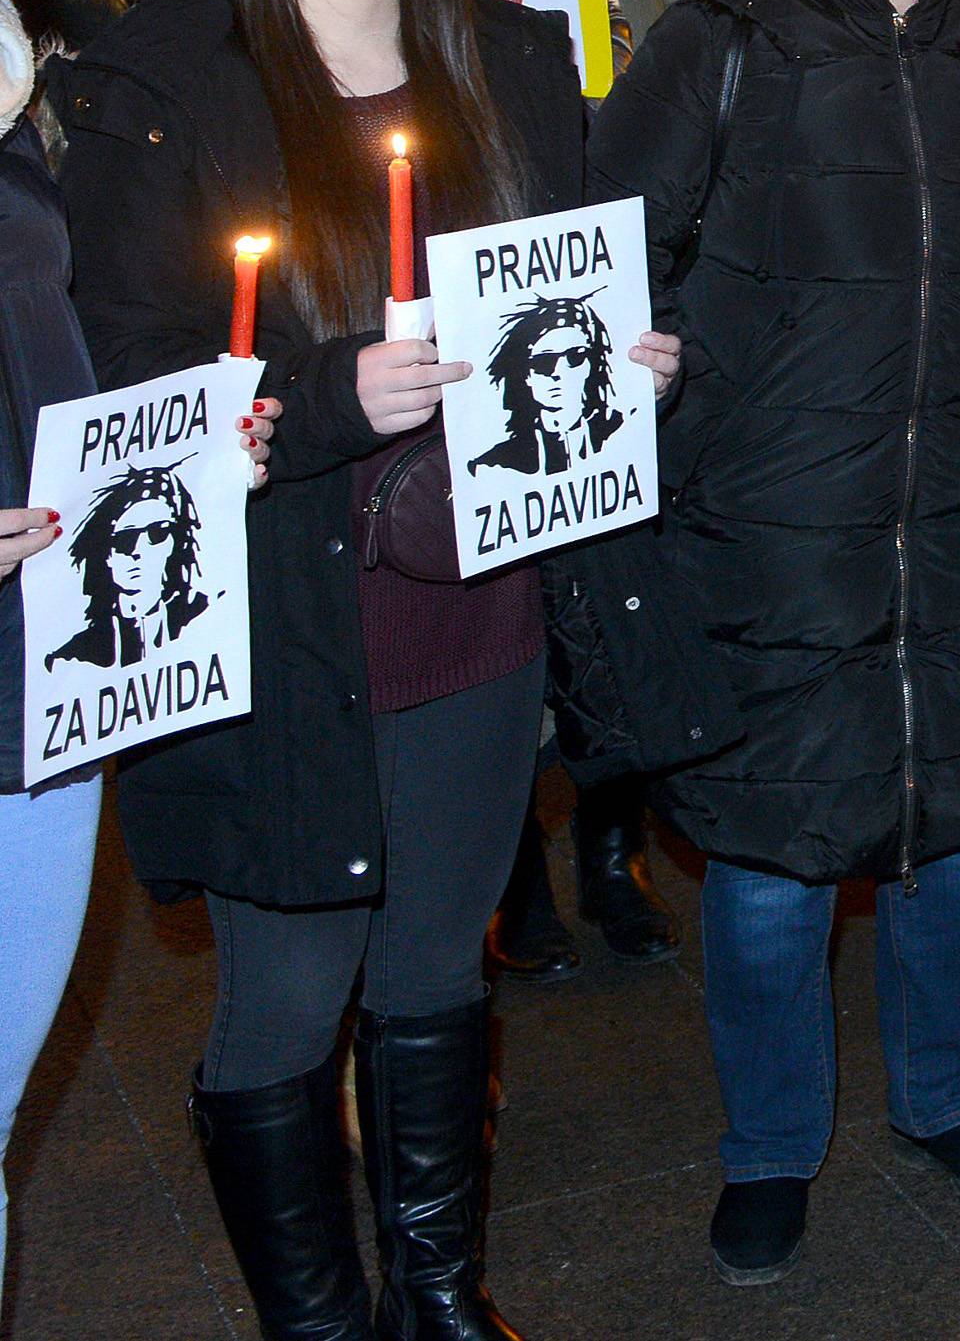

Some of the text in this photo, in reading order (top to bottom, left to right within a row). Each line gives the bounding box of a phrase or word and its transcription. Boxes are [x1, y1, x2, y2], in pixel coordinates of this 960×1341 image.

[475, 226, 613, 297] PRAVDA
[80, 387, 208, 472] PRAVDA
[475, 464, 643, 556] ZA DAVIDA
[43, 653, 229, 761] ZA DAVIDA
